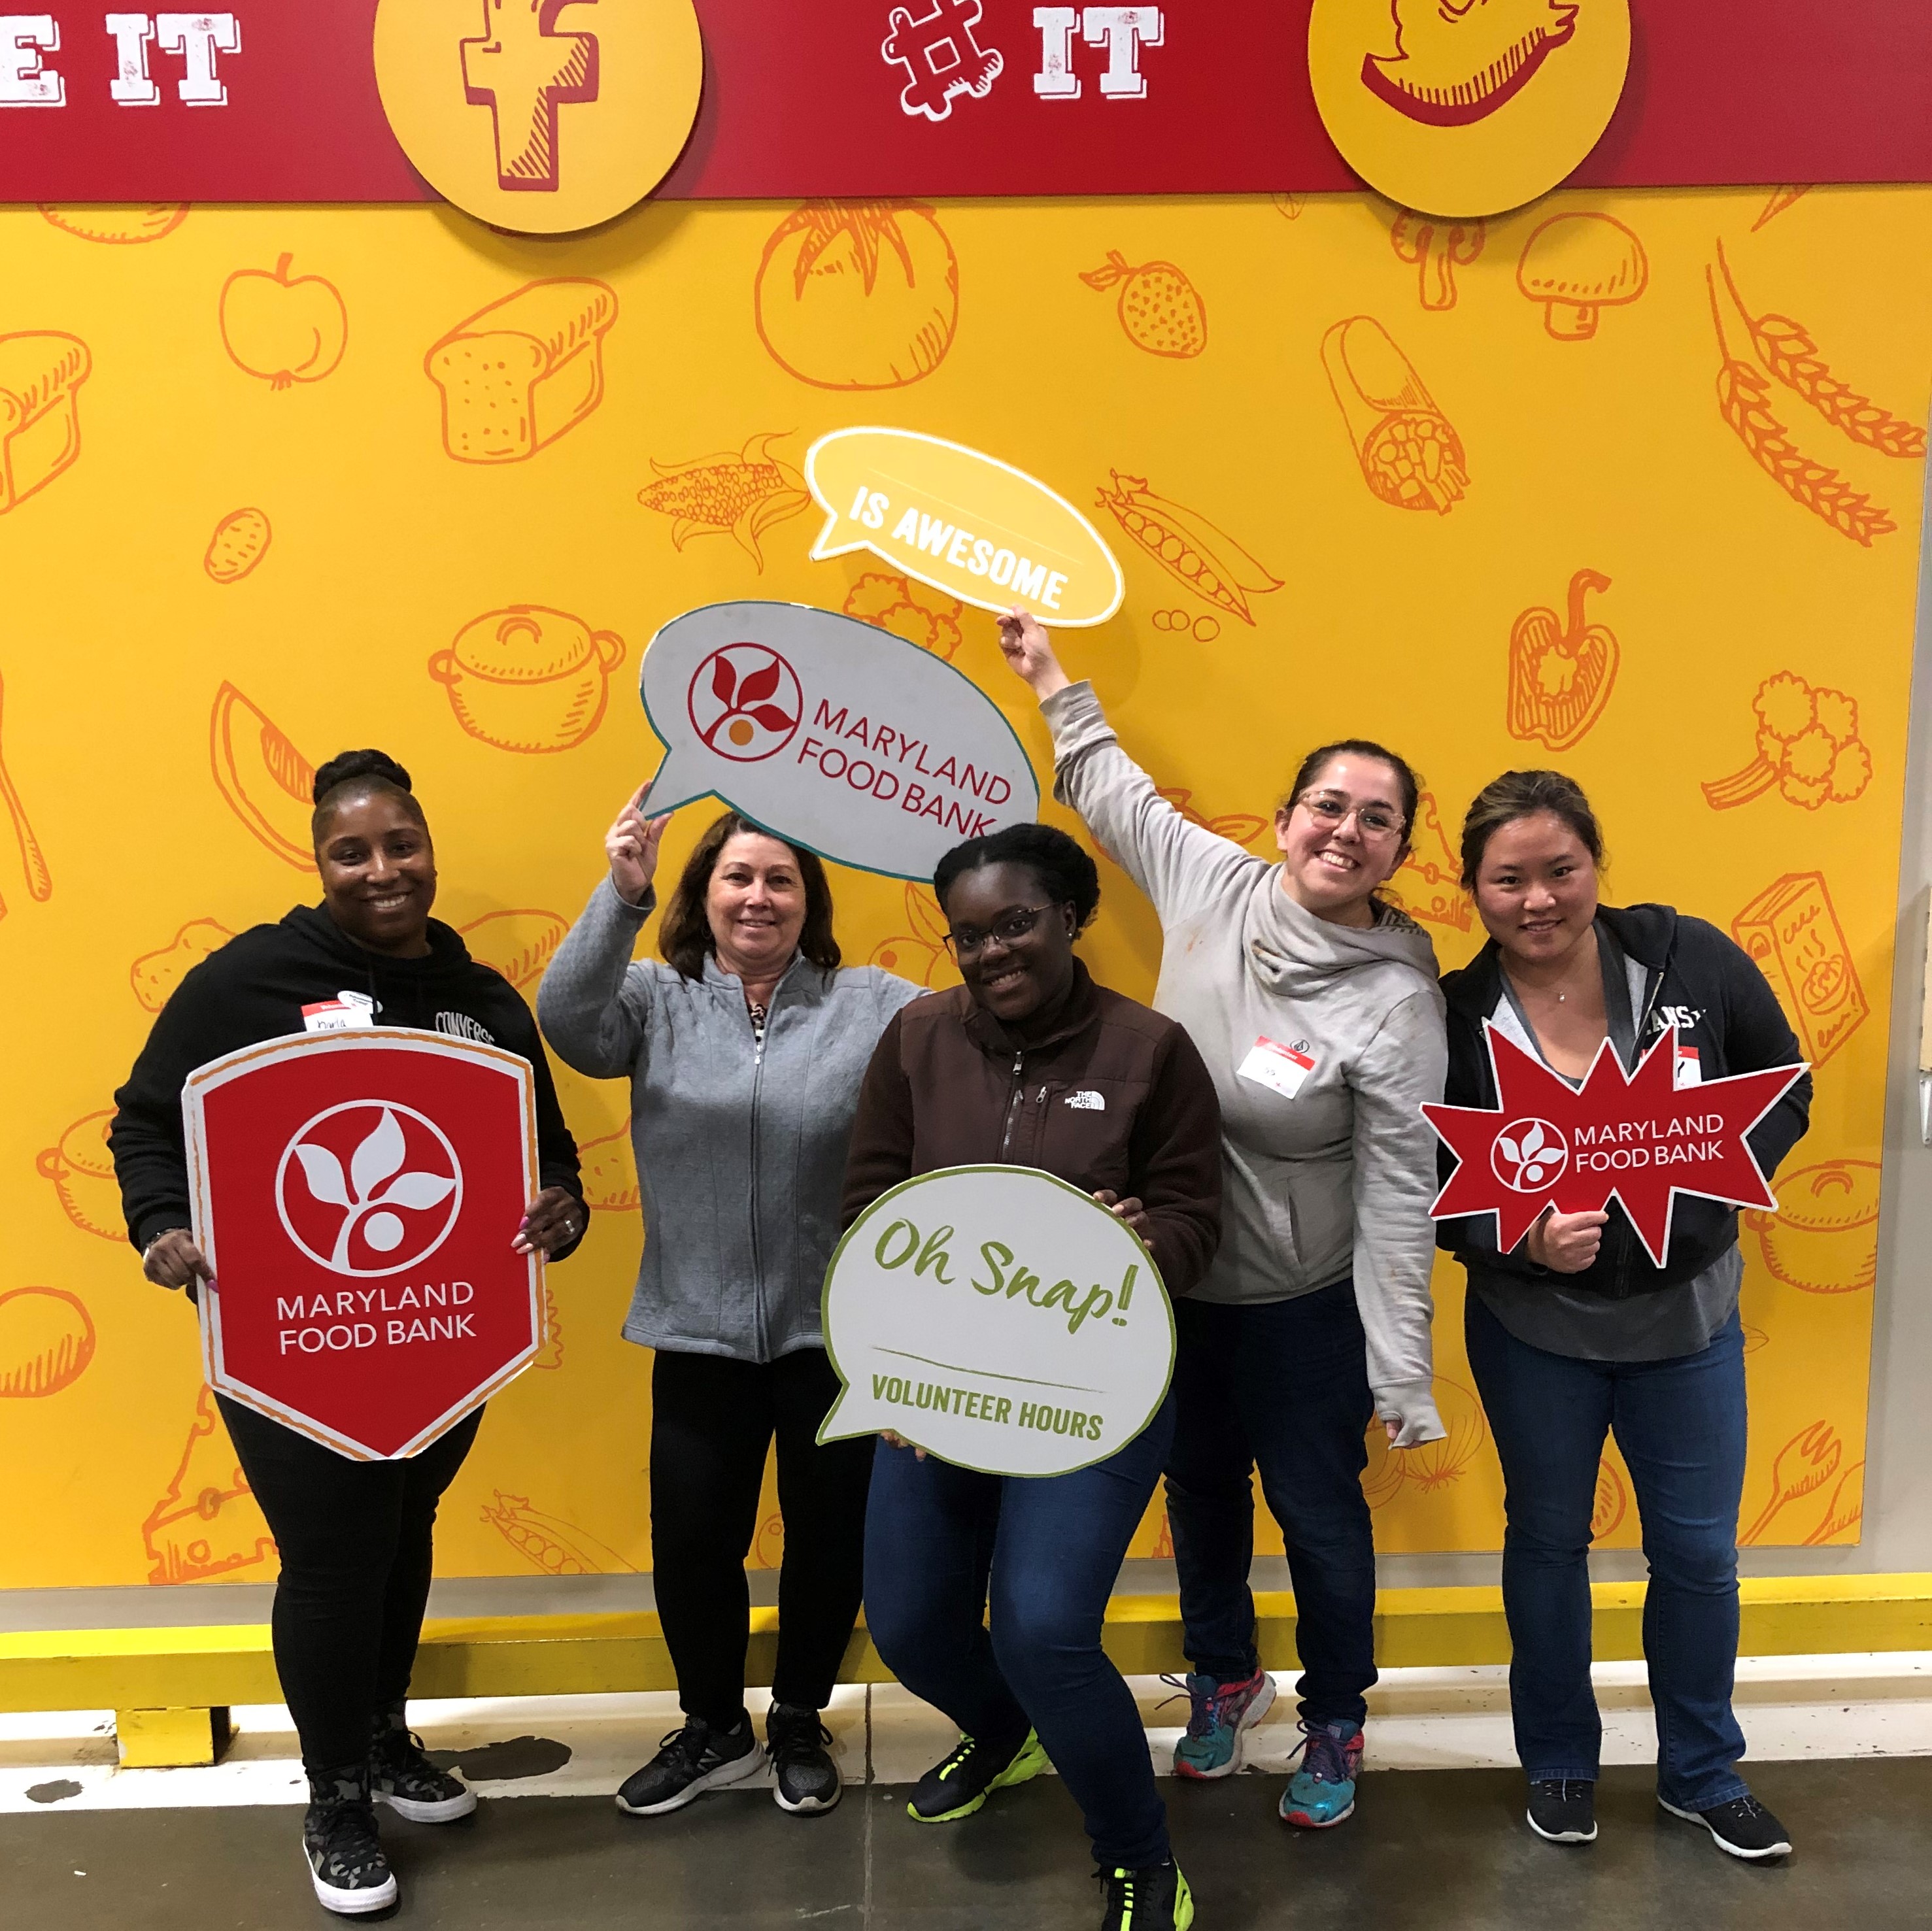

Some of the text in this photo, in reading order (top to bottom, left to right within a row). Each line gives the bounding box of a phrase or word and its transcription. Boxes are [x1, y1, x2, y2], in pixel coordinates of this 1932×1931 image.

[105, 12, 242, 107] IT
[1032, 6, 1164, 100] IT
[849, 486, 1069, 611] IS AWESOME
[797, 736, 996, 837] FOOD BANK
[813, 699, 1011, 805] MARYLAND
[1574, 1114, 1724, 1147] MARYLAND
[1576, 1140, 1725, 1173] FOOD BANK
[277, 1281, 475, 1321] MARYLAND
[875, 1218, 1140, 1335] Oh Snap!
[280, 1313, 477, 1355] FOOD BANK
[872, 1373, 1104, 1441] VOLUNTEER HOURS
